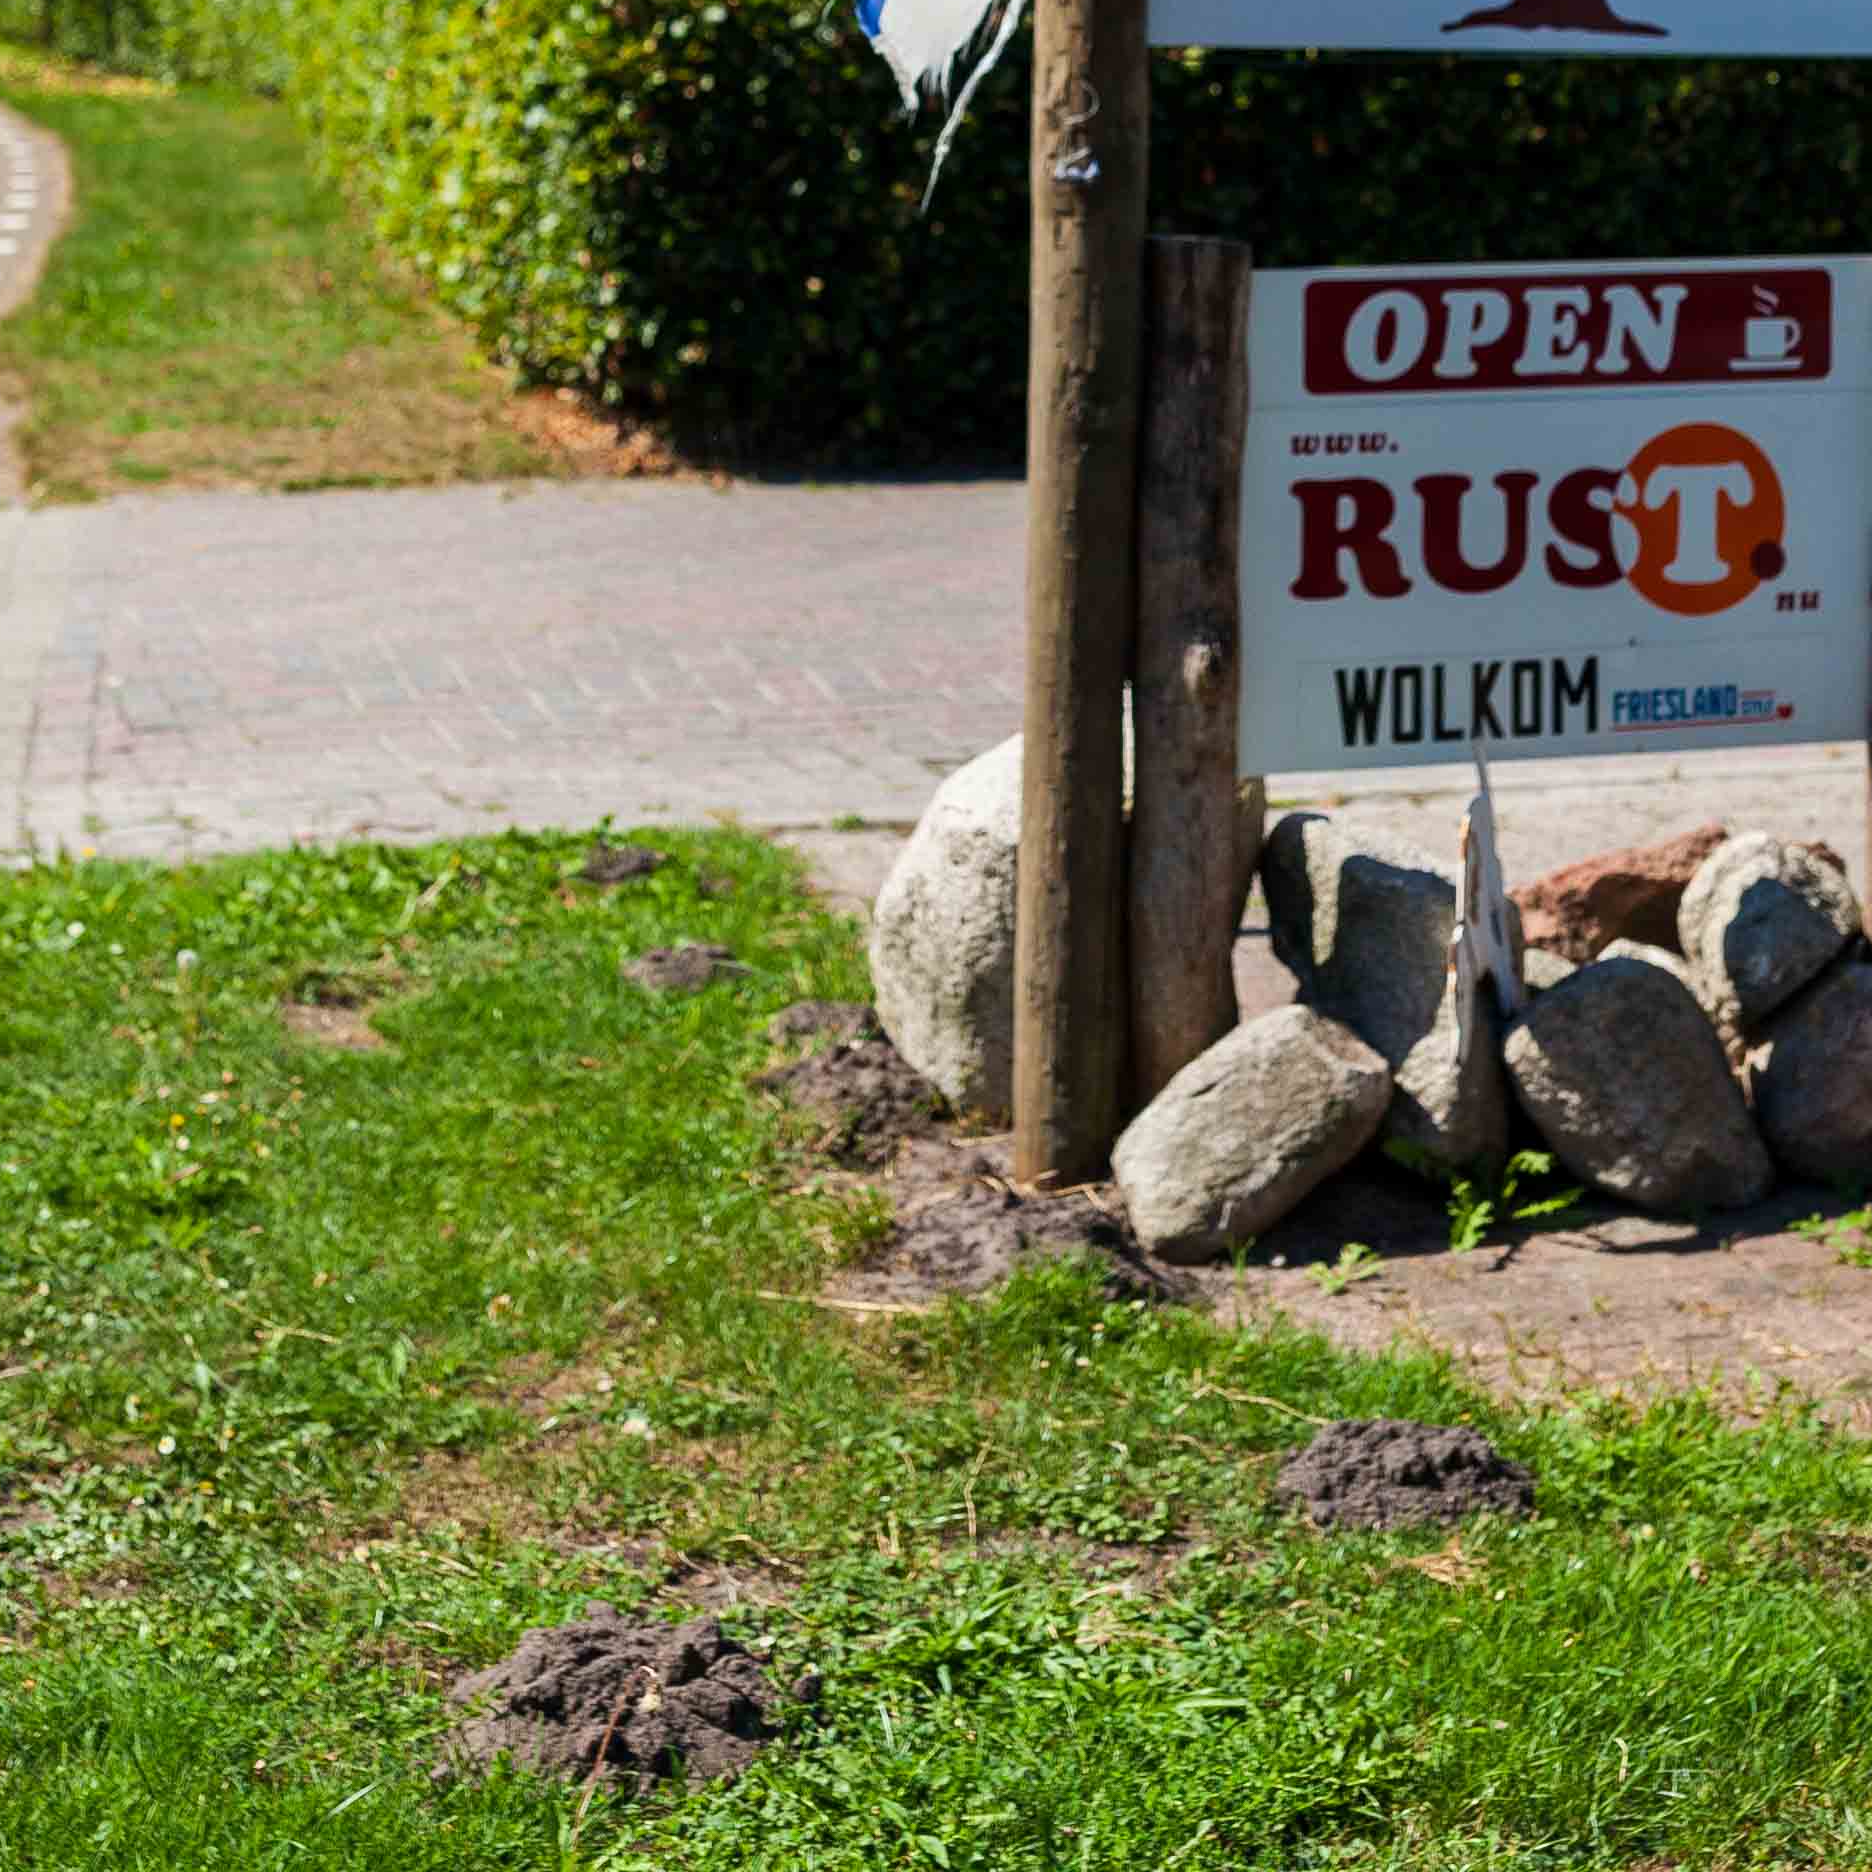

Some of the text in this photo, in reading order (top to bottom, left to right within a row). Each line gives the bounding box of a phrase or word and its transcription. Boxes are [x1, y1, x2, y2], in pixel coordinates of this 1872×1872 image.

[1343, 283, 1688, 383] OPEN
[1290, 432, 1399, 456] www.
[1334, 655, 1738, 747] WOLKOM FRIESLAND
